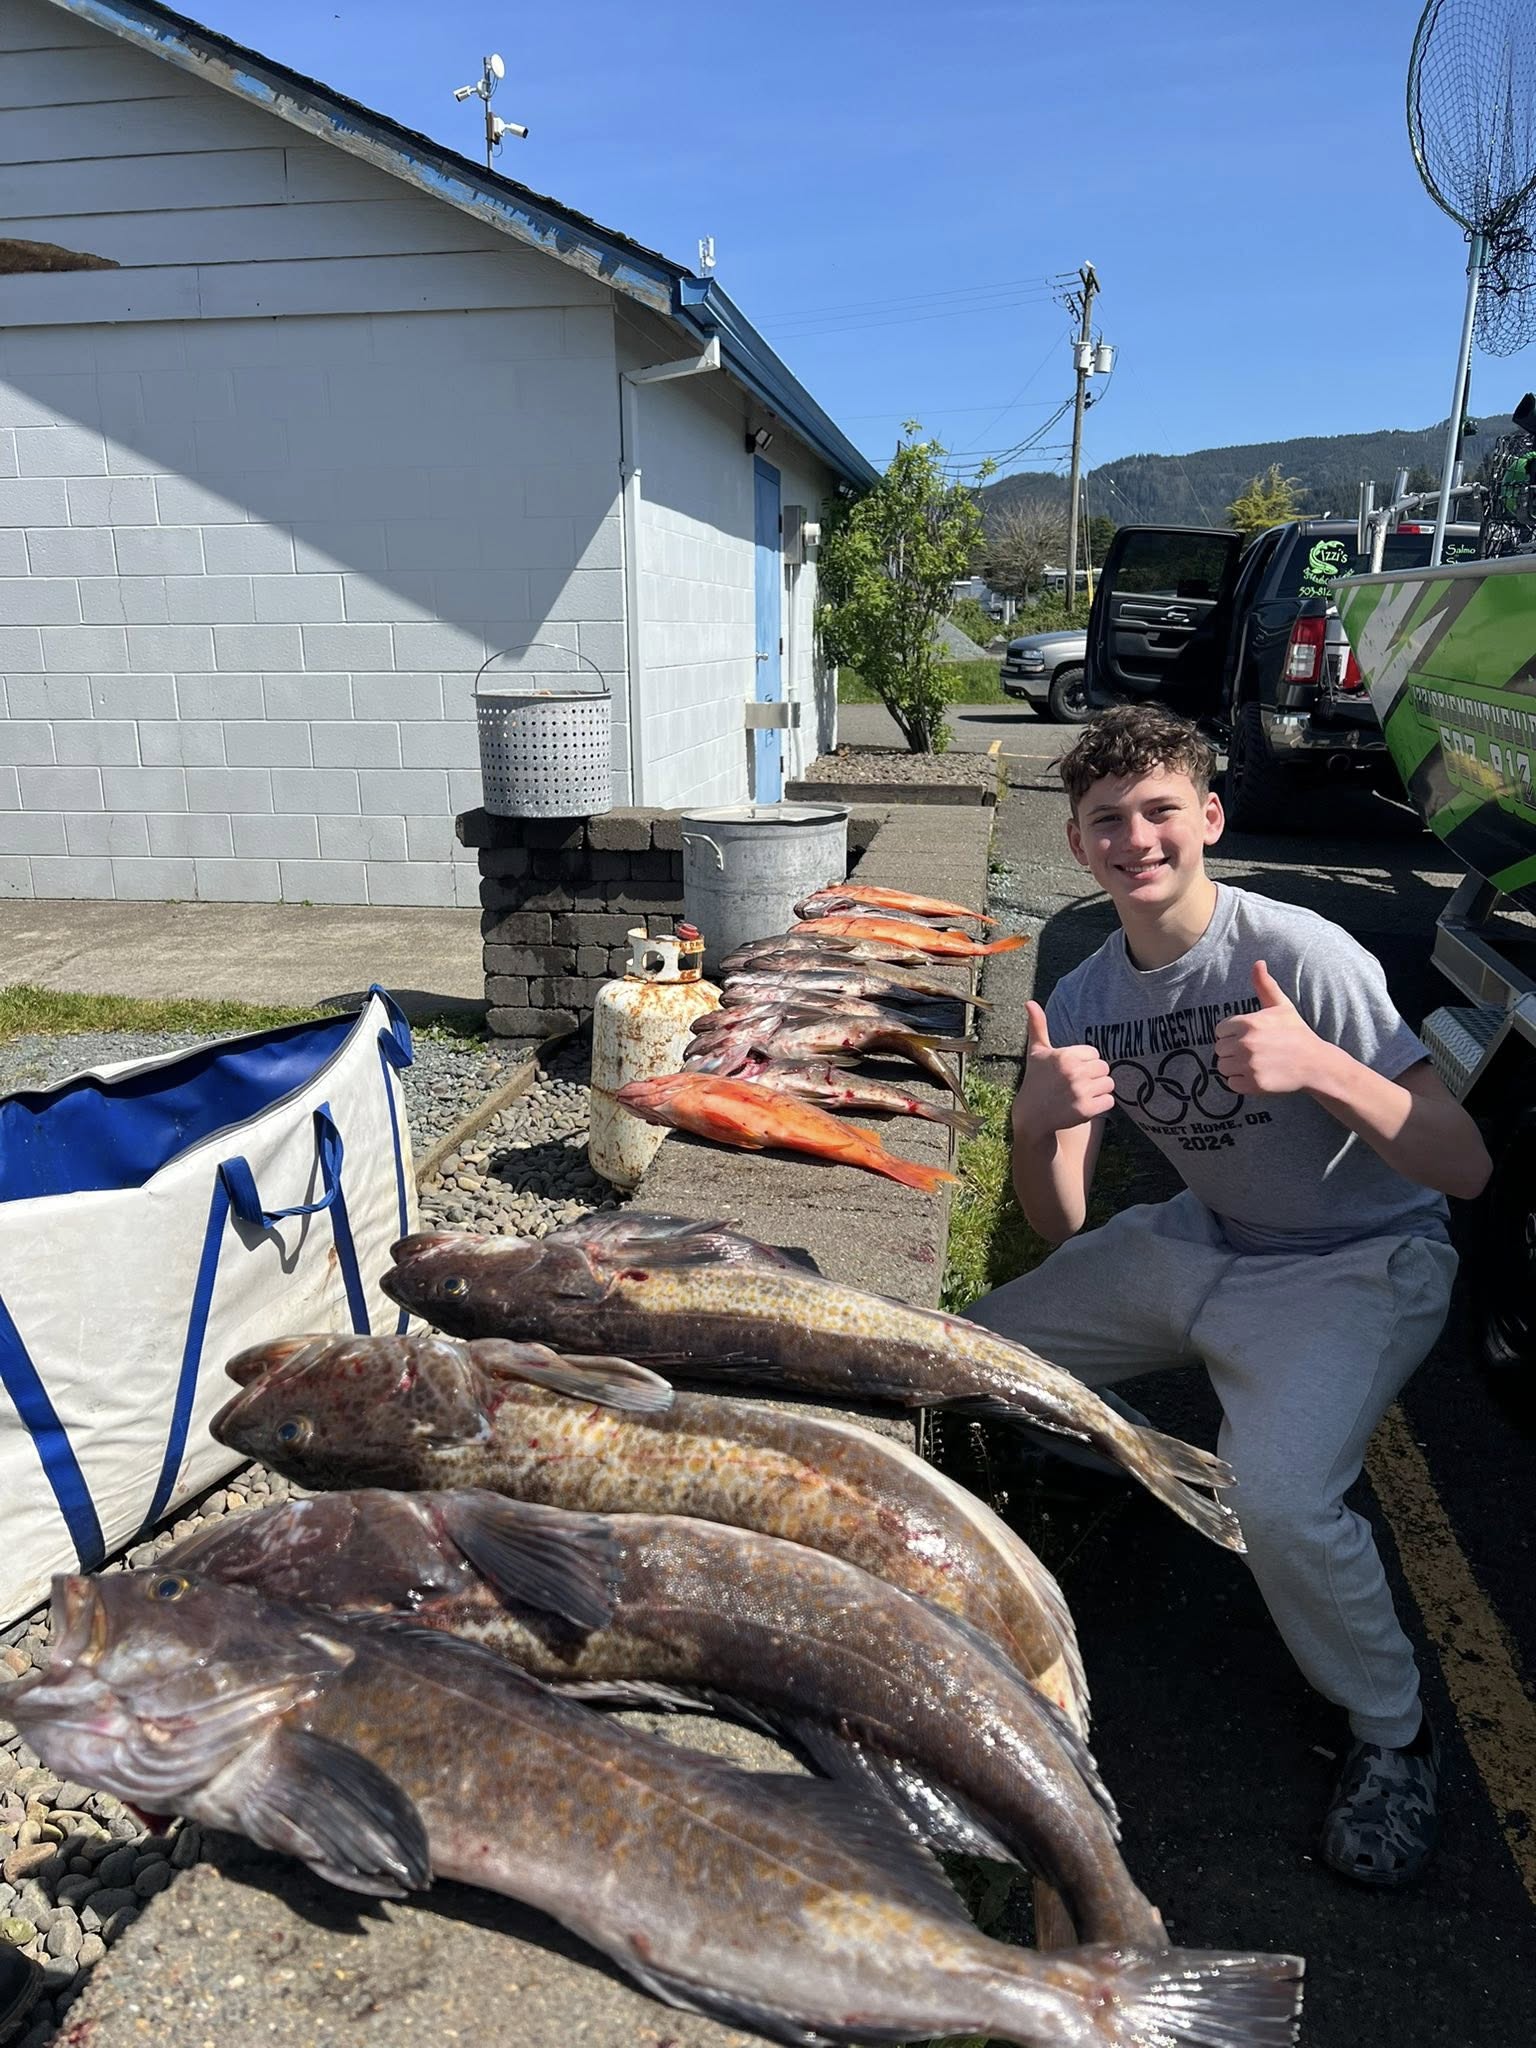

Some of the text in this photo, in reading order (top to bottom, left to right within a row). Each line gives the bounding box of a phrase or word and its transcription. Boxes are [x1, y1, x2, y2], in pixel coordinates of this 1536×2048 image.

[1321, 548, 1348, 563] Izzi's
[1245, 1111, 1273, 1126] OR
[1178, 1133, 1236, 1152] 2024
